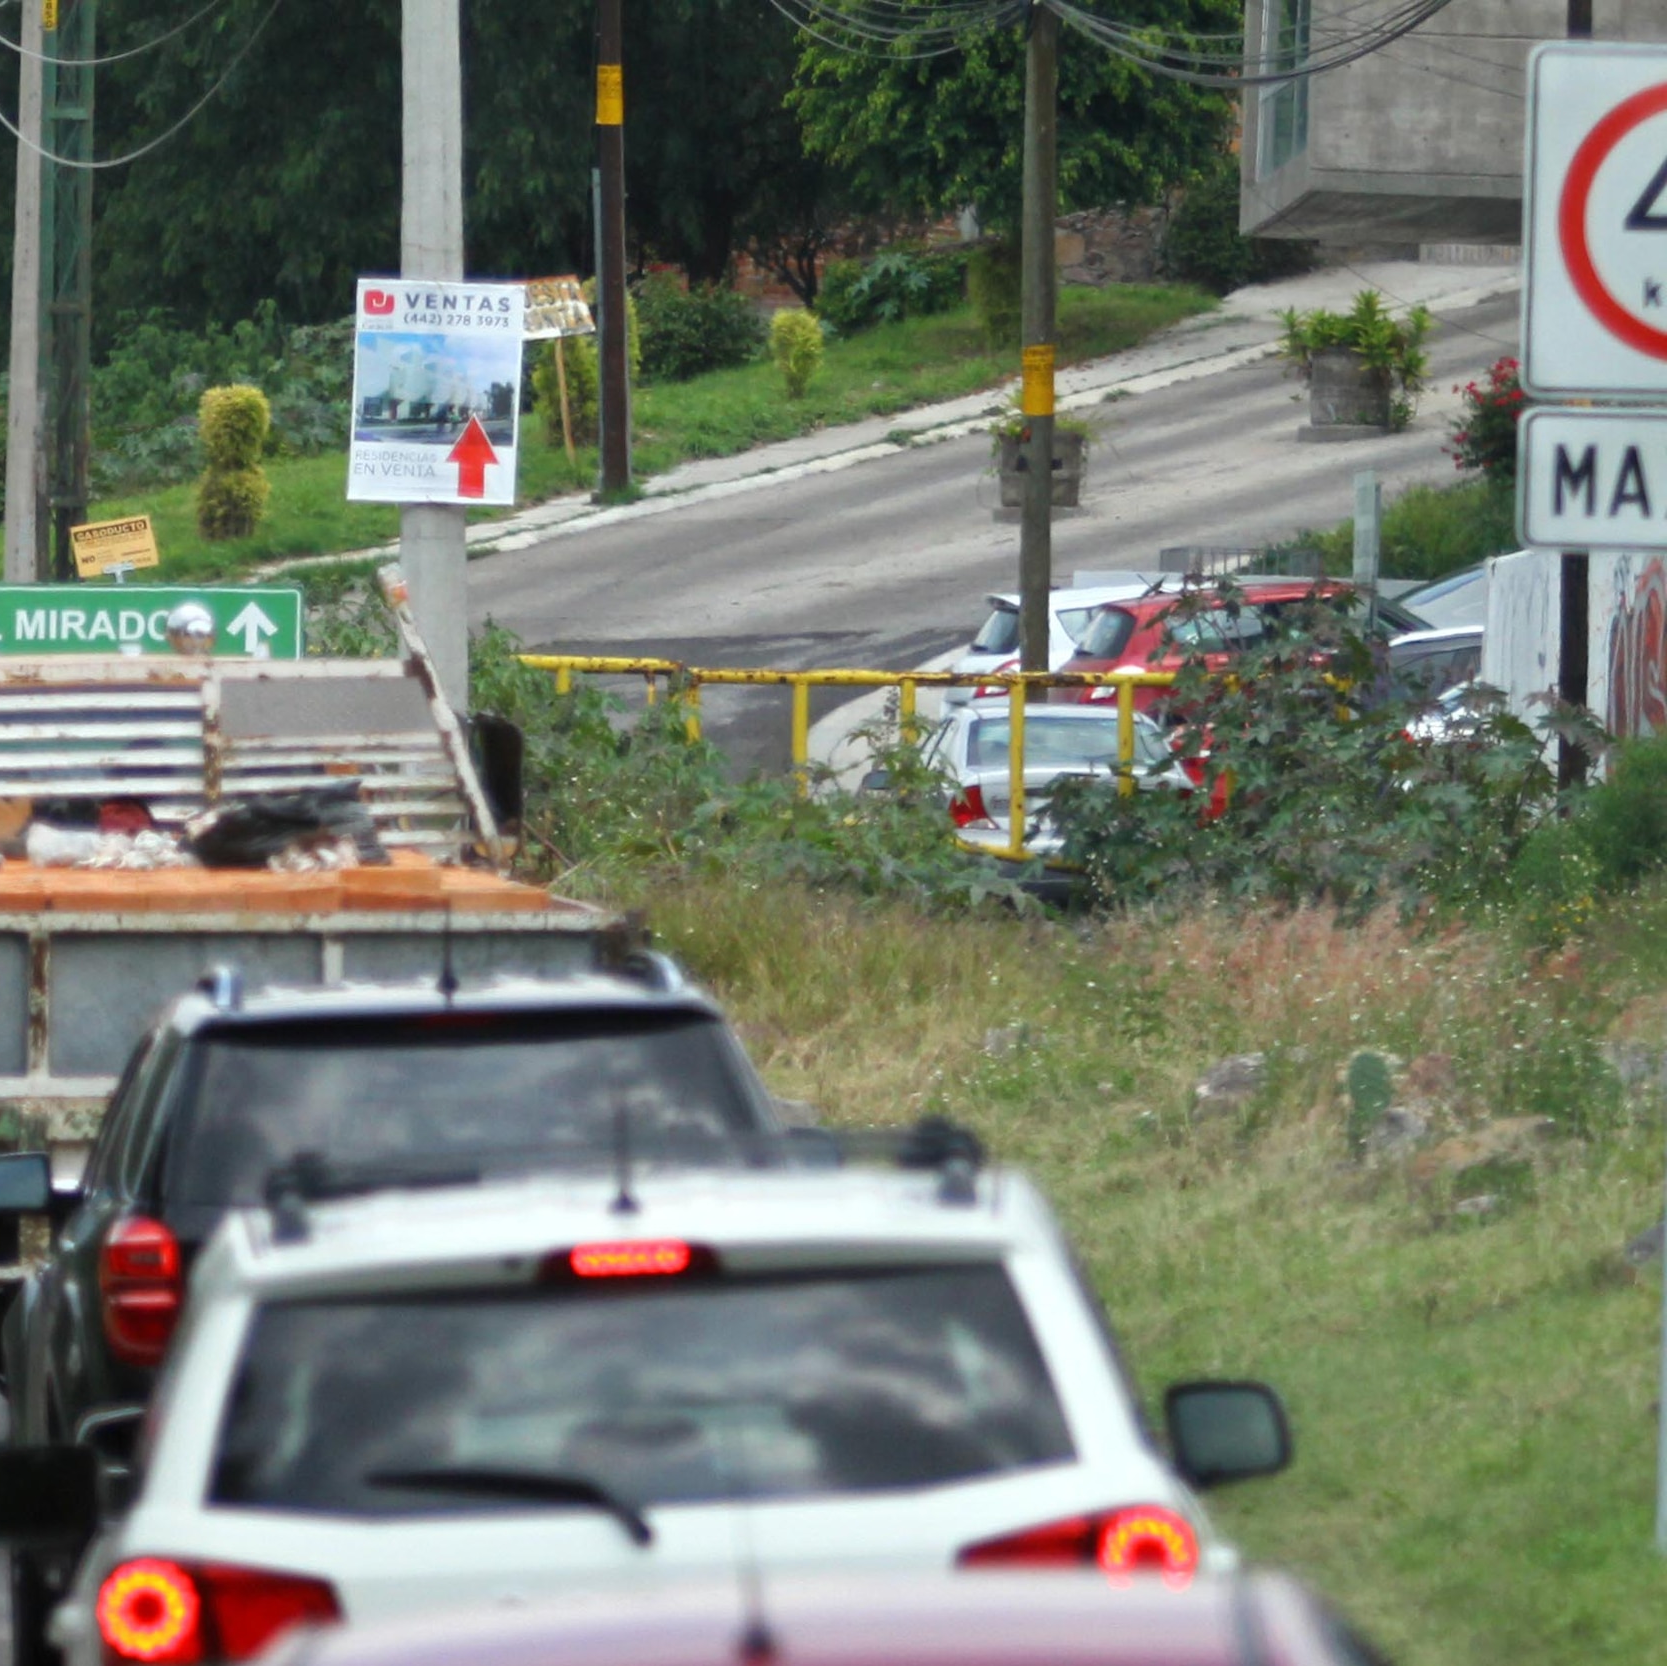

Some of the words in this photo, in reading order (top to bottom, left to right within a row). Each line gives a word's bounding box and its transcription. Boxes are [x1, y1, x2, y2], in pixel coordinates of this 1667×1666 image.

[405, 293, 510, 312] VENTAS
[403, 313, 442, 325] (442)
[448, 314, 471, 326] 278
[476, 315, 510, 328] 3973
[354, 463, 376, 475] EN
[381, 463, 436, 477] VENTA
[1553, 443, 1667, 518] MA
[16, 610, 170, 642] MIRADO
